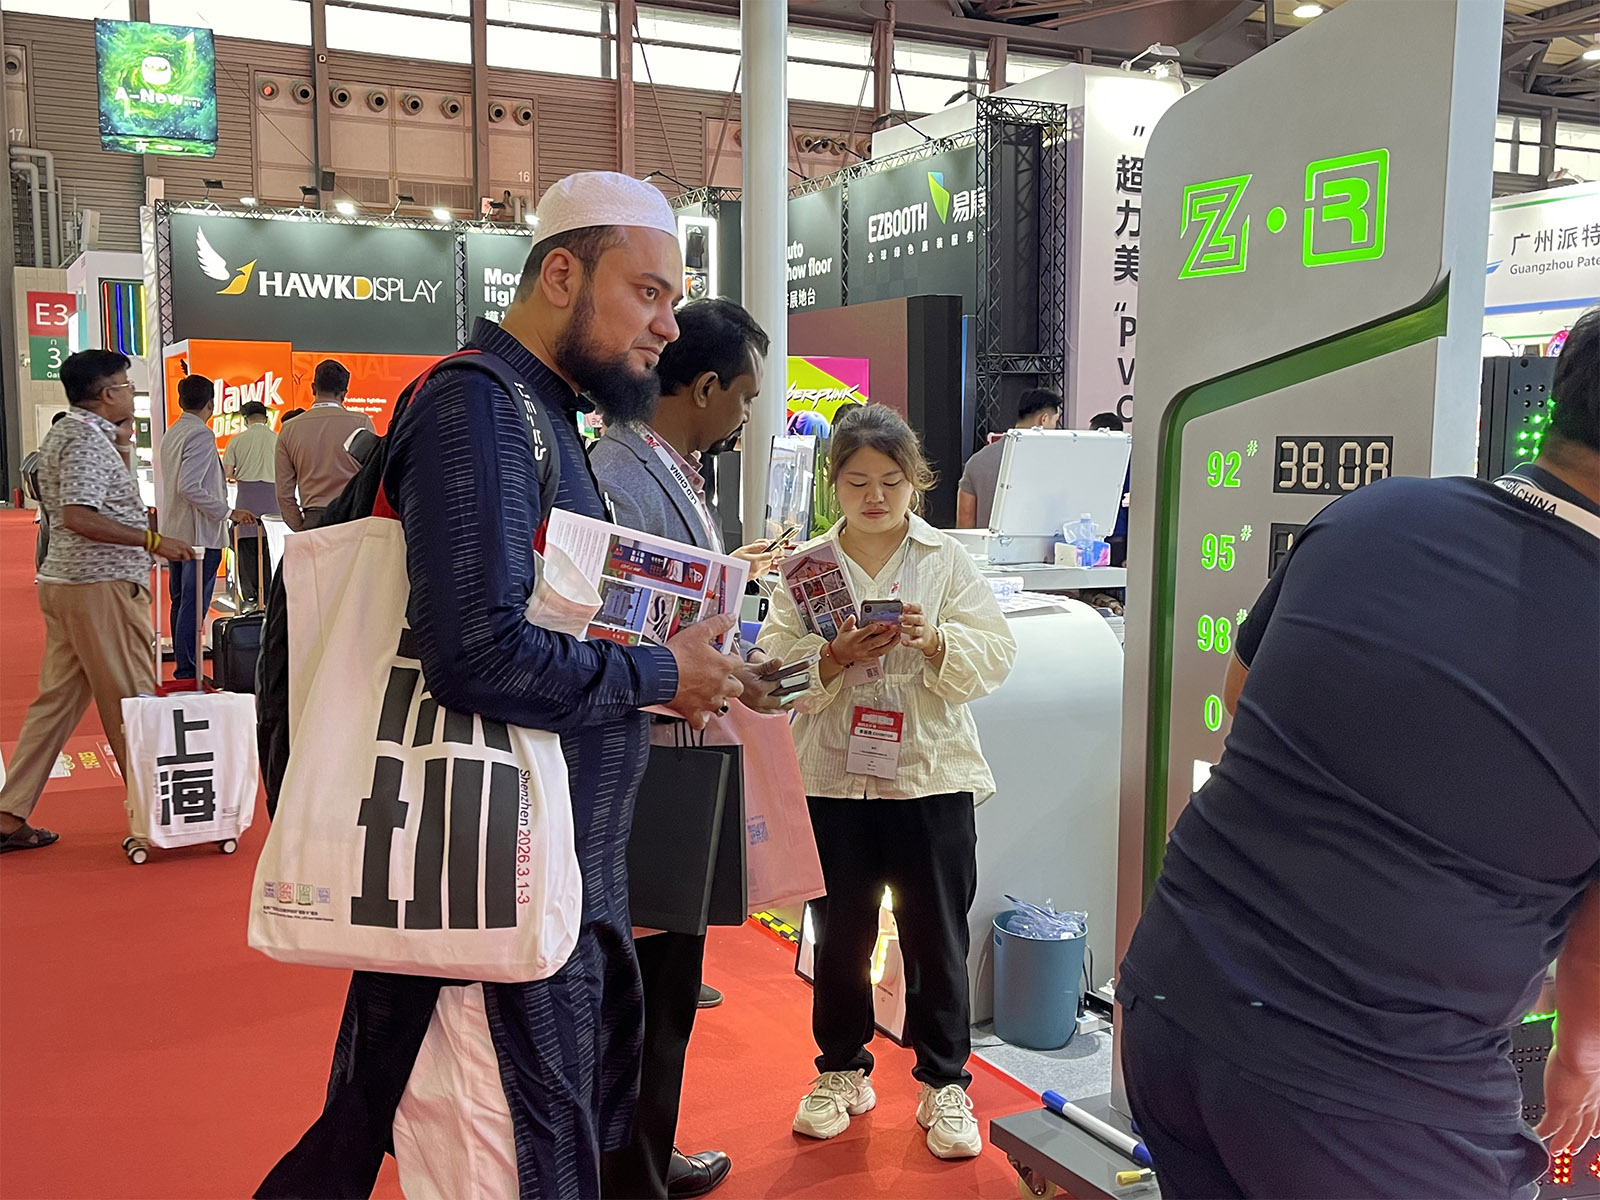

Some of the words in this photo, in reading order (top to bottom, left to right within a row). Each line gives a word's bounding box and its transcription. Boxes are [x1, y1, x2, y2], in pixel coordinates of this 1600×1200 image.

[9, 128, 24, 141] 17
[518, 171, 530, 182] 16
[868, 201, 928, 243] EZBOOTH
[786, 240, 804, 260] uto
[1510, 222, 1600, 256] 广州派特
[786, 263, 807, 281] how
[808, 256, 833, 277] floor
[1509, 259, 1574, 275] Guangzhou
[258, 270, 443, 304] HAWKDISPLAY
[35, 302, 69, 326] E3
[47, 347, 63, 369] 3
[669, 463, 689, 489] CHINA
[1516, 488, 1558, 515] CHINA
[1204, 694, 1223, 731] 0
[157, 708, 217, 826] 上海
[519, 769, 533, 827] Shenzhen
